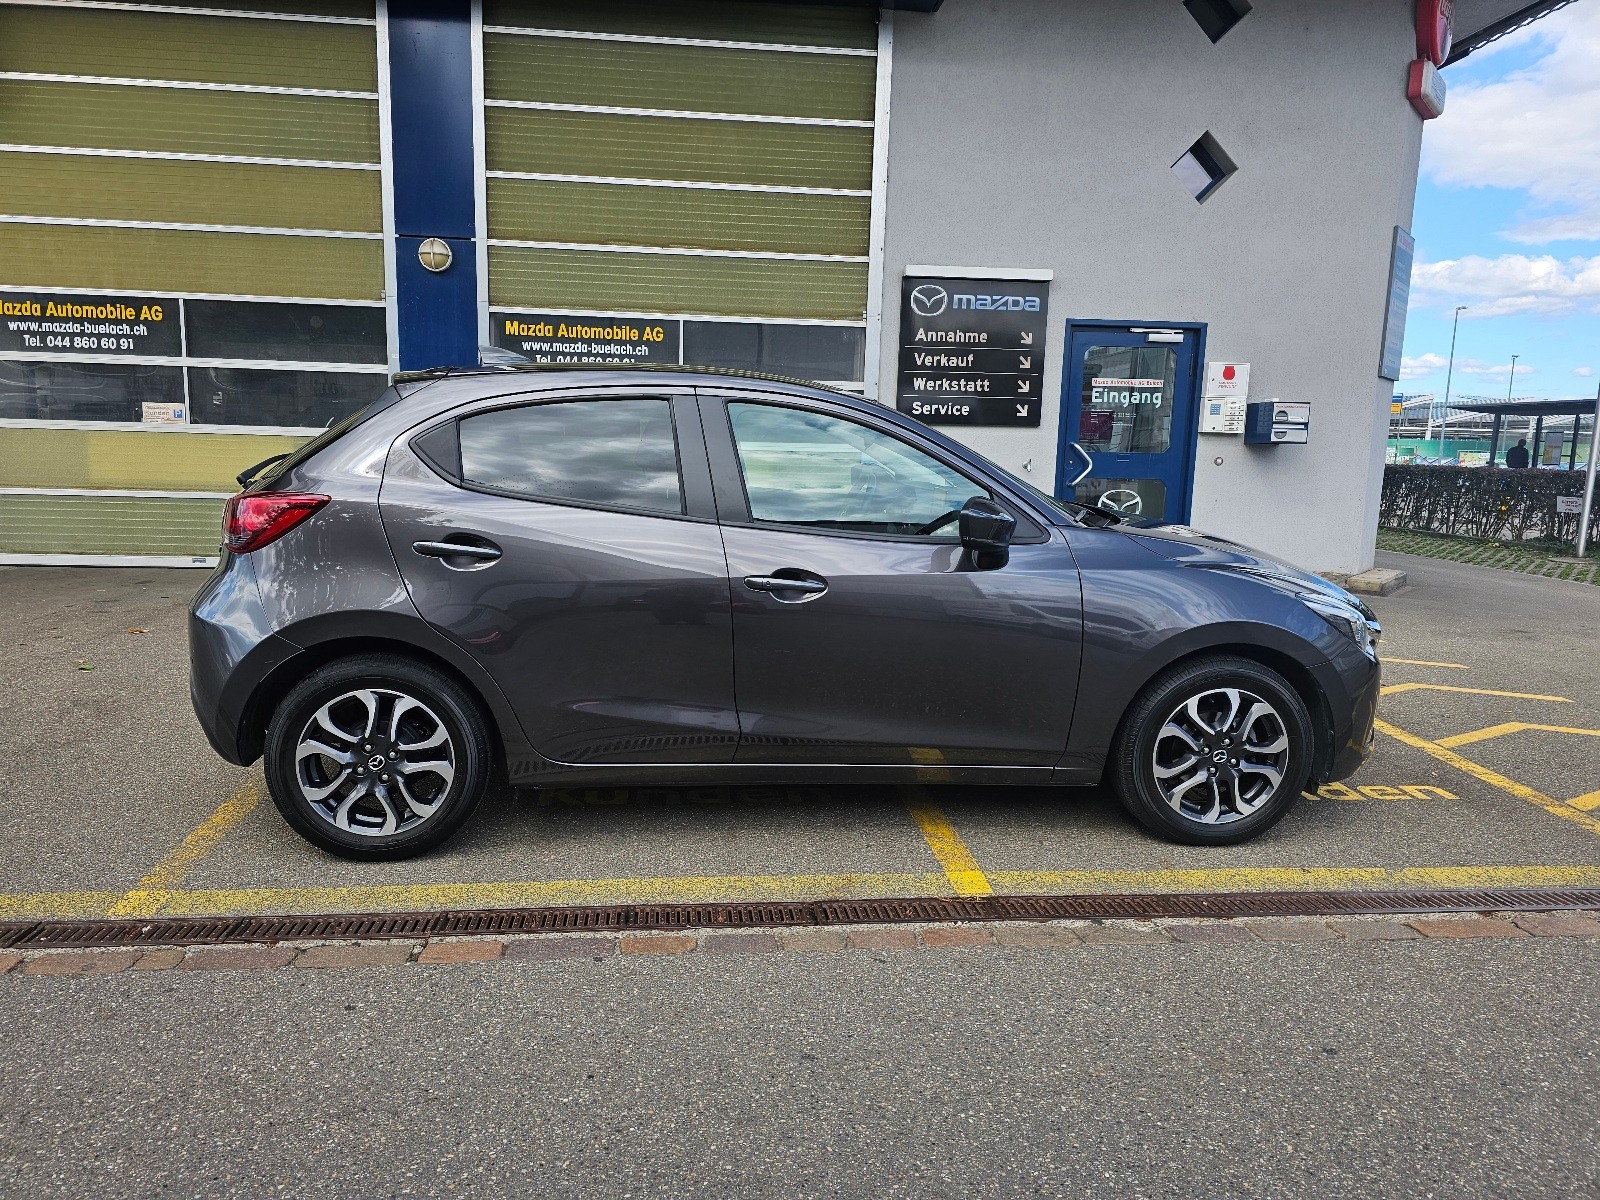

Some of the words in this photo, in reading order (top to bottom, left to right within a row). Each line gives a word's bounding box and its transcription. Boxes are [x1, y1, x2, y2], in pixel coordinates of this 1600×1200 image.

[952, 294, 1041, 312] mazda
[0, 301, 41, 316] azda
[46, 302, 136, 320] Automobile
[140, 305, 163, 321] AG
[8, 321, 148, 336] www.mazda-buelach.ch
[505, 321, 554, 337] Mazda
[557, 323, 639, 341] Automobile
[642, 327, 664, 342] AG
[914, 328, 988, 343] Annahme
[23, 335, 43, 347] Tel.
[47, 335, 70, 348] 044
[74, 337, 97, 349] 860
[100, 338, 118, 349] 60
[120, 339, 134, 350] 91
[522, 340, 649, 356] www.mazda-buelach.ch
[914, 352, 974, 367] Verkauf
[913, 377, 990, 392] Werkstatt
[1091, 387, 1163, 409] Eingang
[912, 402, 970, 416] Service
[1301, 780, 1461, 801] den
